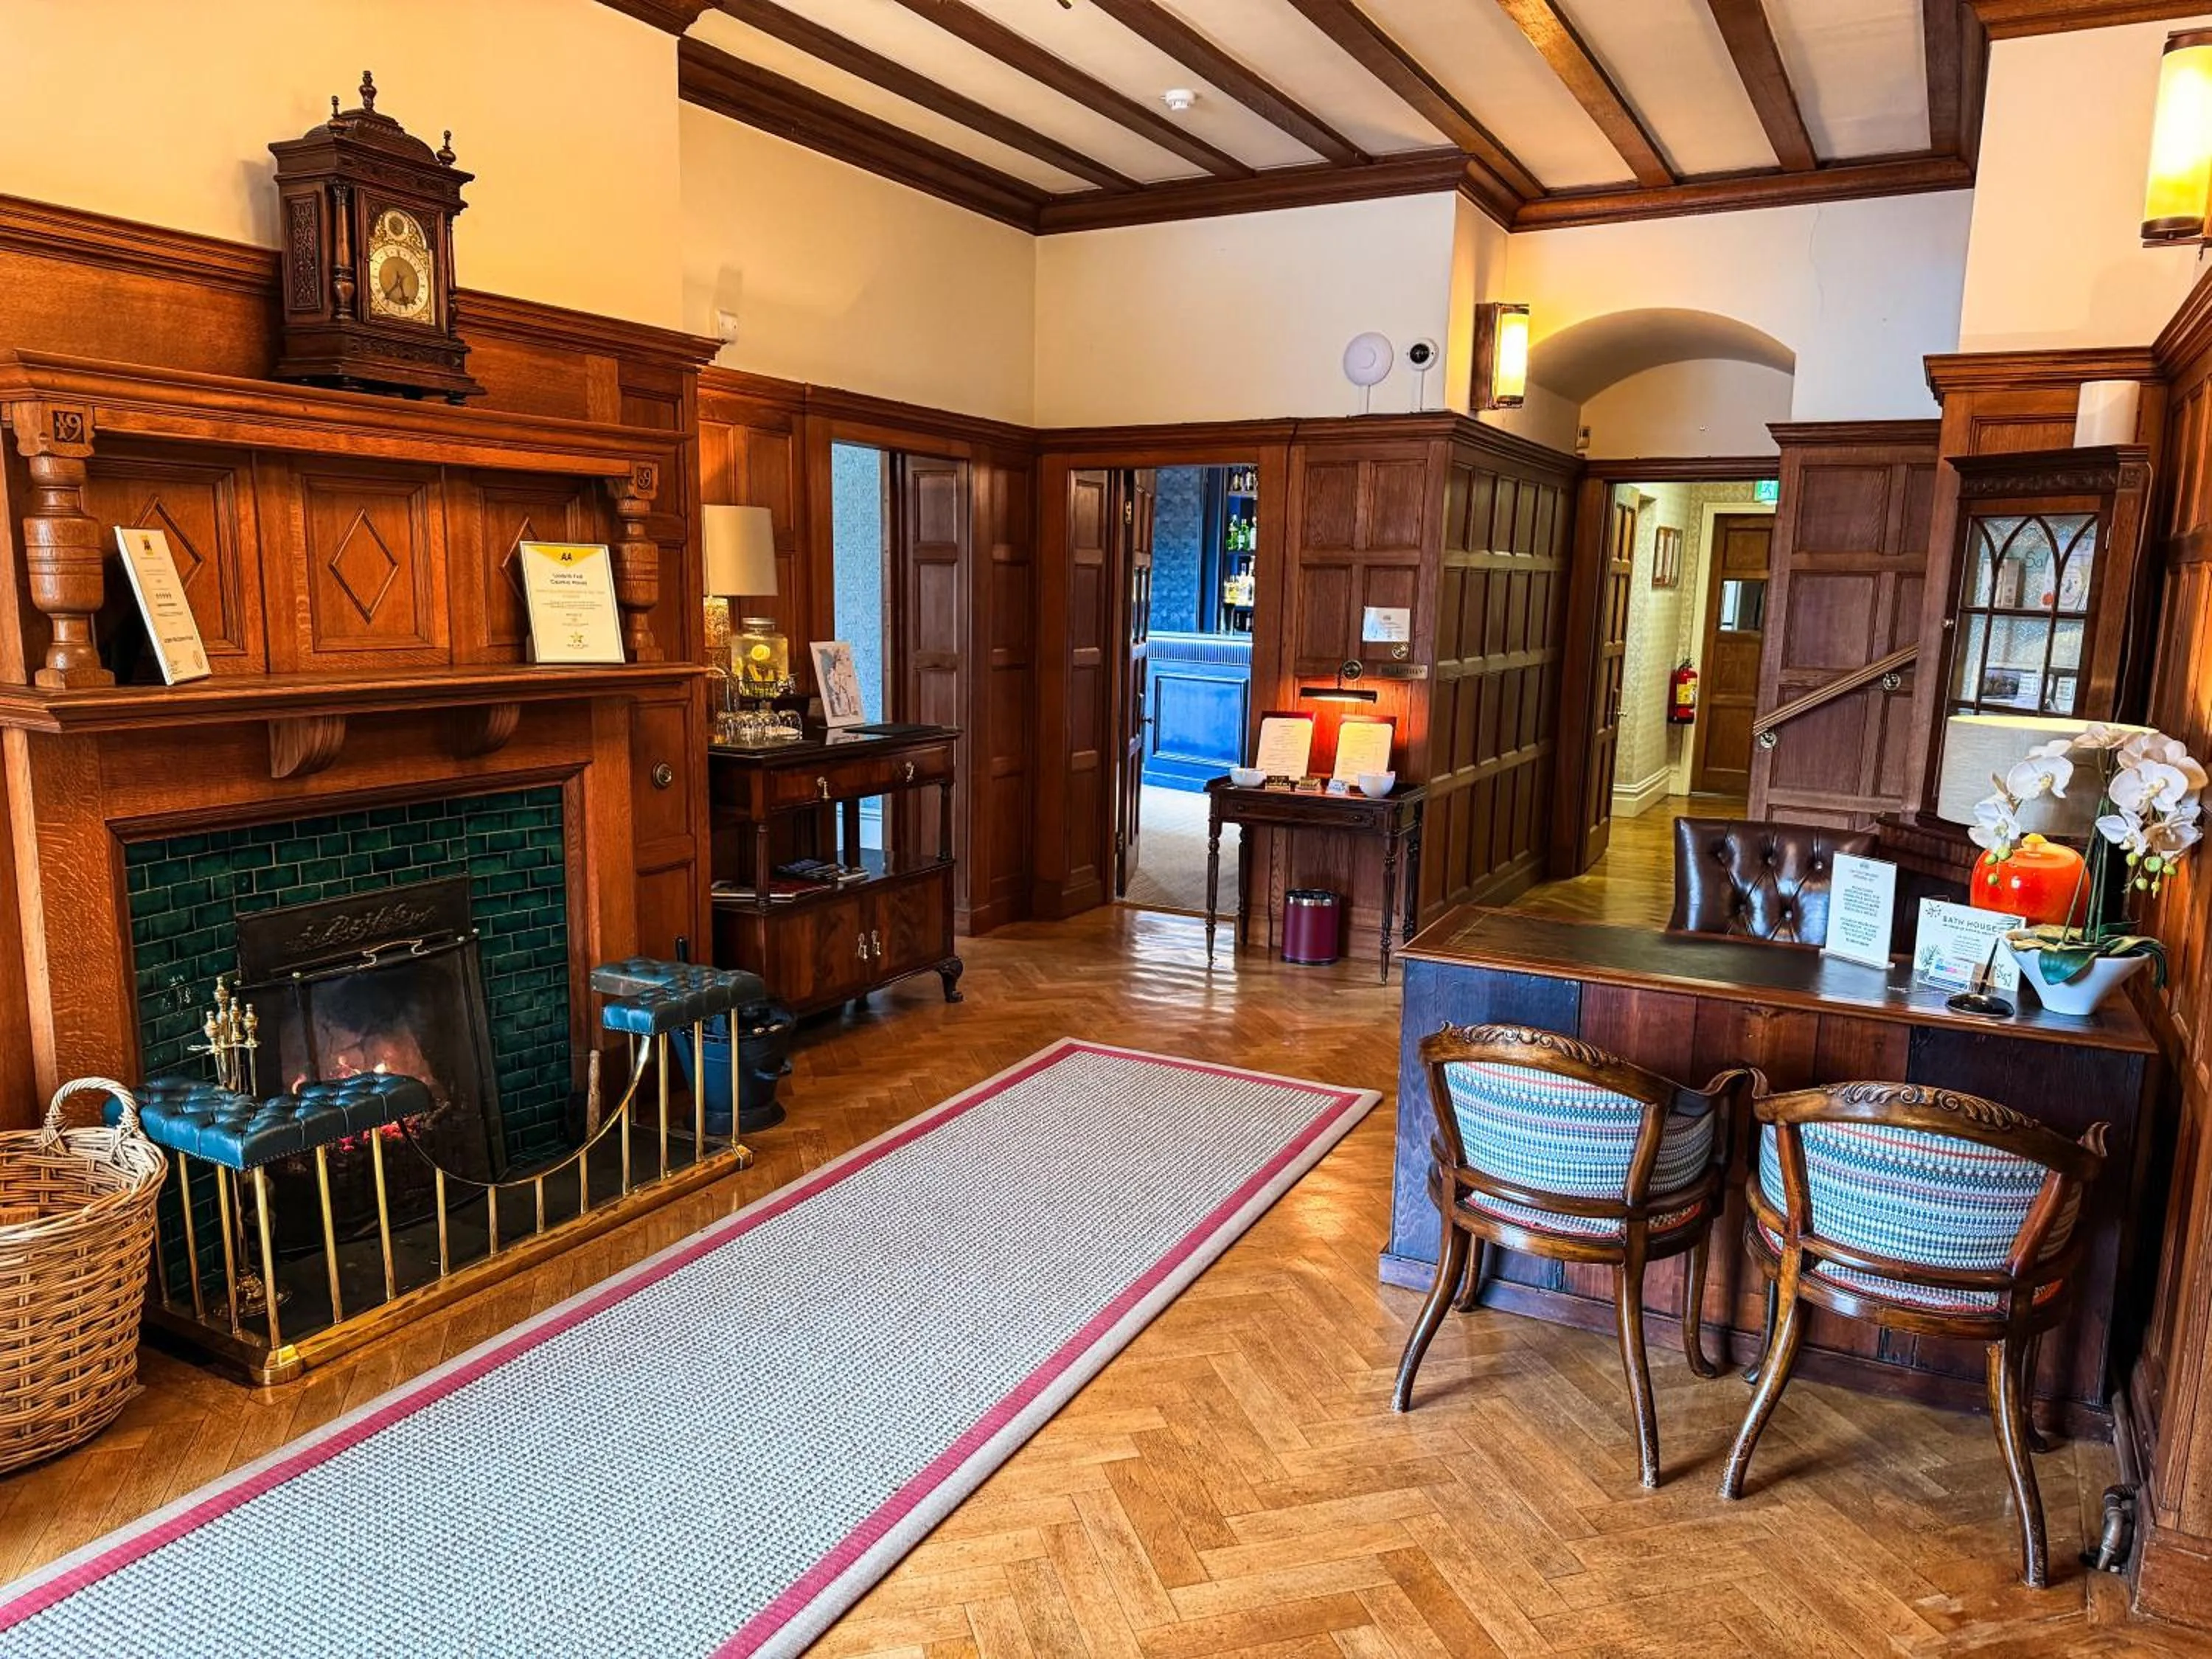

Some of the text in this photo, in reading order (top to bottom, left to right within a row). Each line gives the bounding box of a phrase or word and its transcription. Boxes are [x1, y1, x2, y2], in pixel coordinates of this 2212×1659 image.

[560, 553, 572, 561] AA
[1943, 915, 1965, 925] BATH
[1966, 919, 1997, 932] HOUSE
